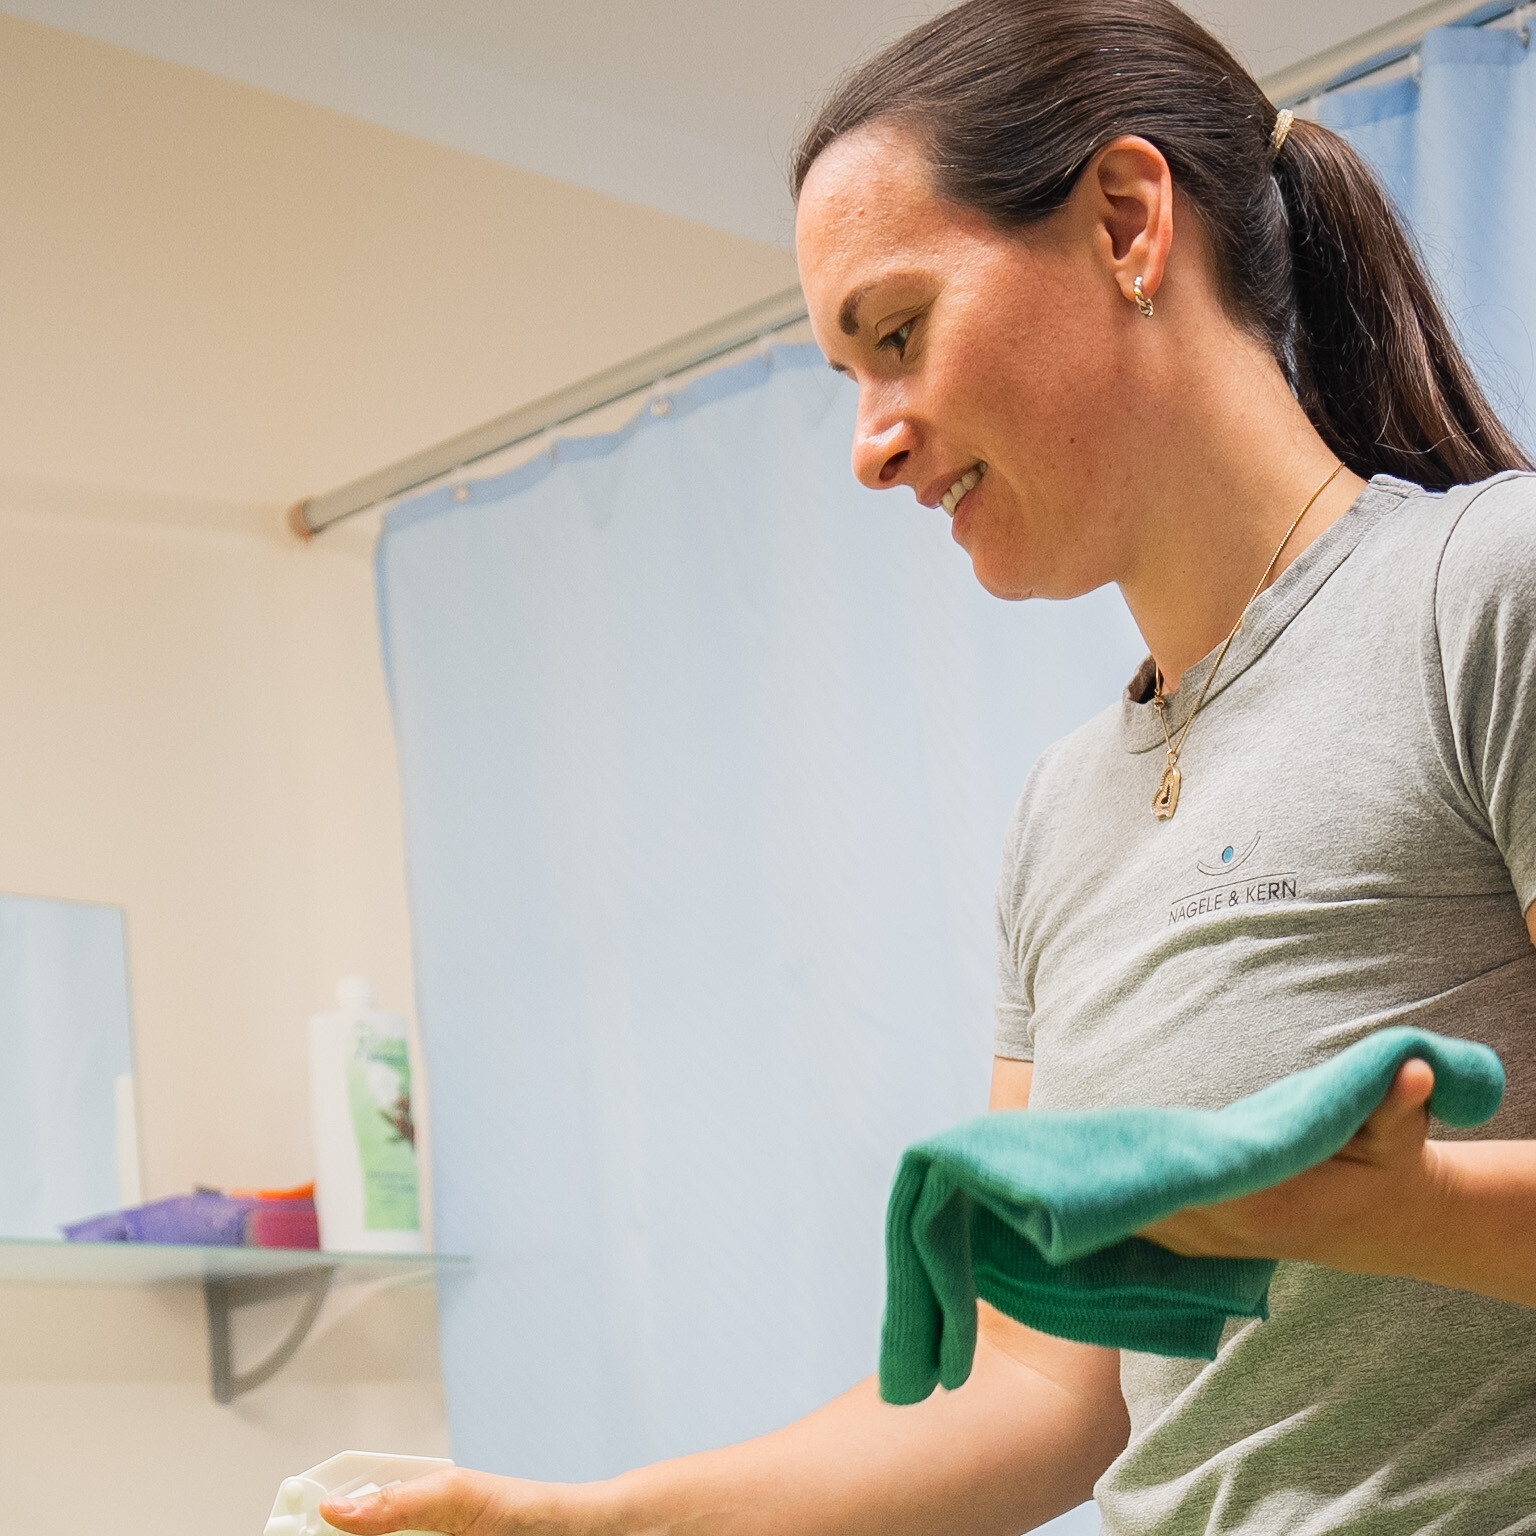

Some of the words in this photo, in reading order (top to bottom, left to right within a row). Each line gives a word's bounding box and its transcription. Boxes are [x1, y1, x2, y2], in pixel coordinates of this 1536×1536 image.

[1168, 894, 1222, 926] NAGELE
[1228, 890, 1239, 906] &
[1246, 880, 1297, 903] KERN
